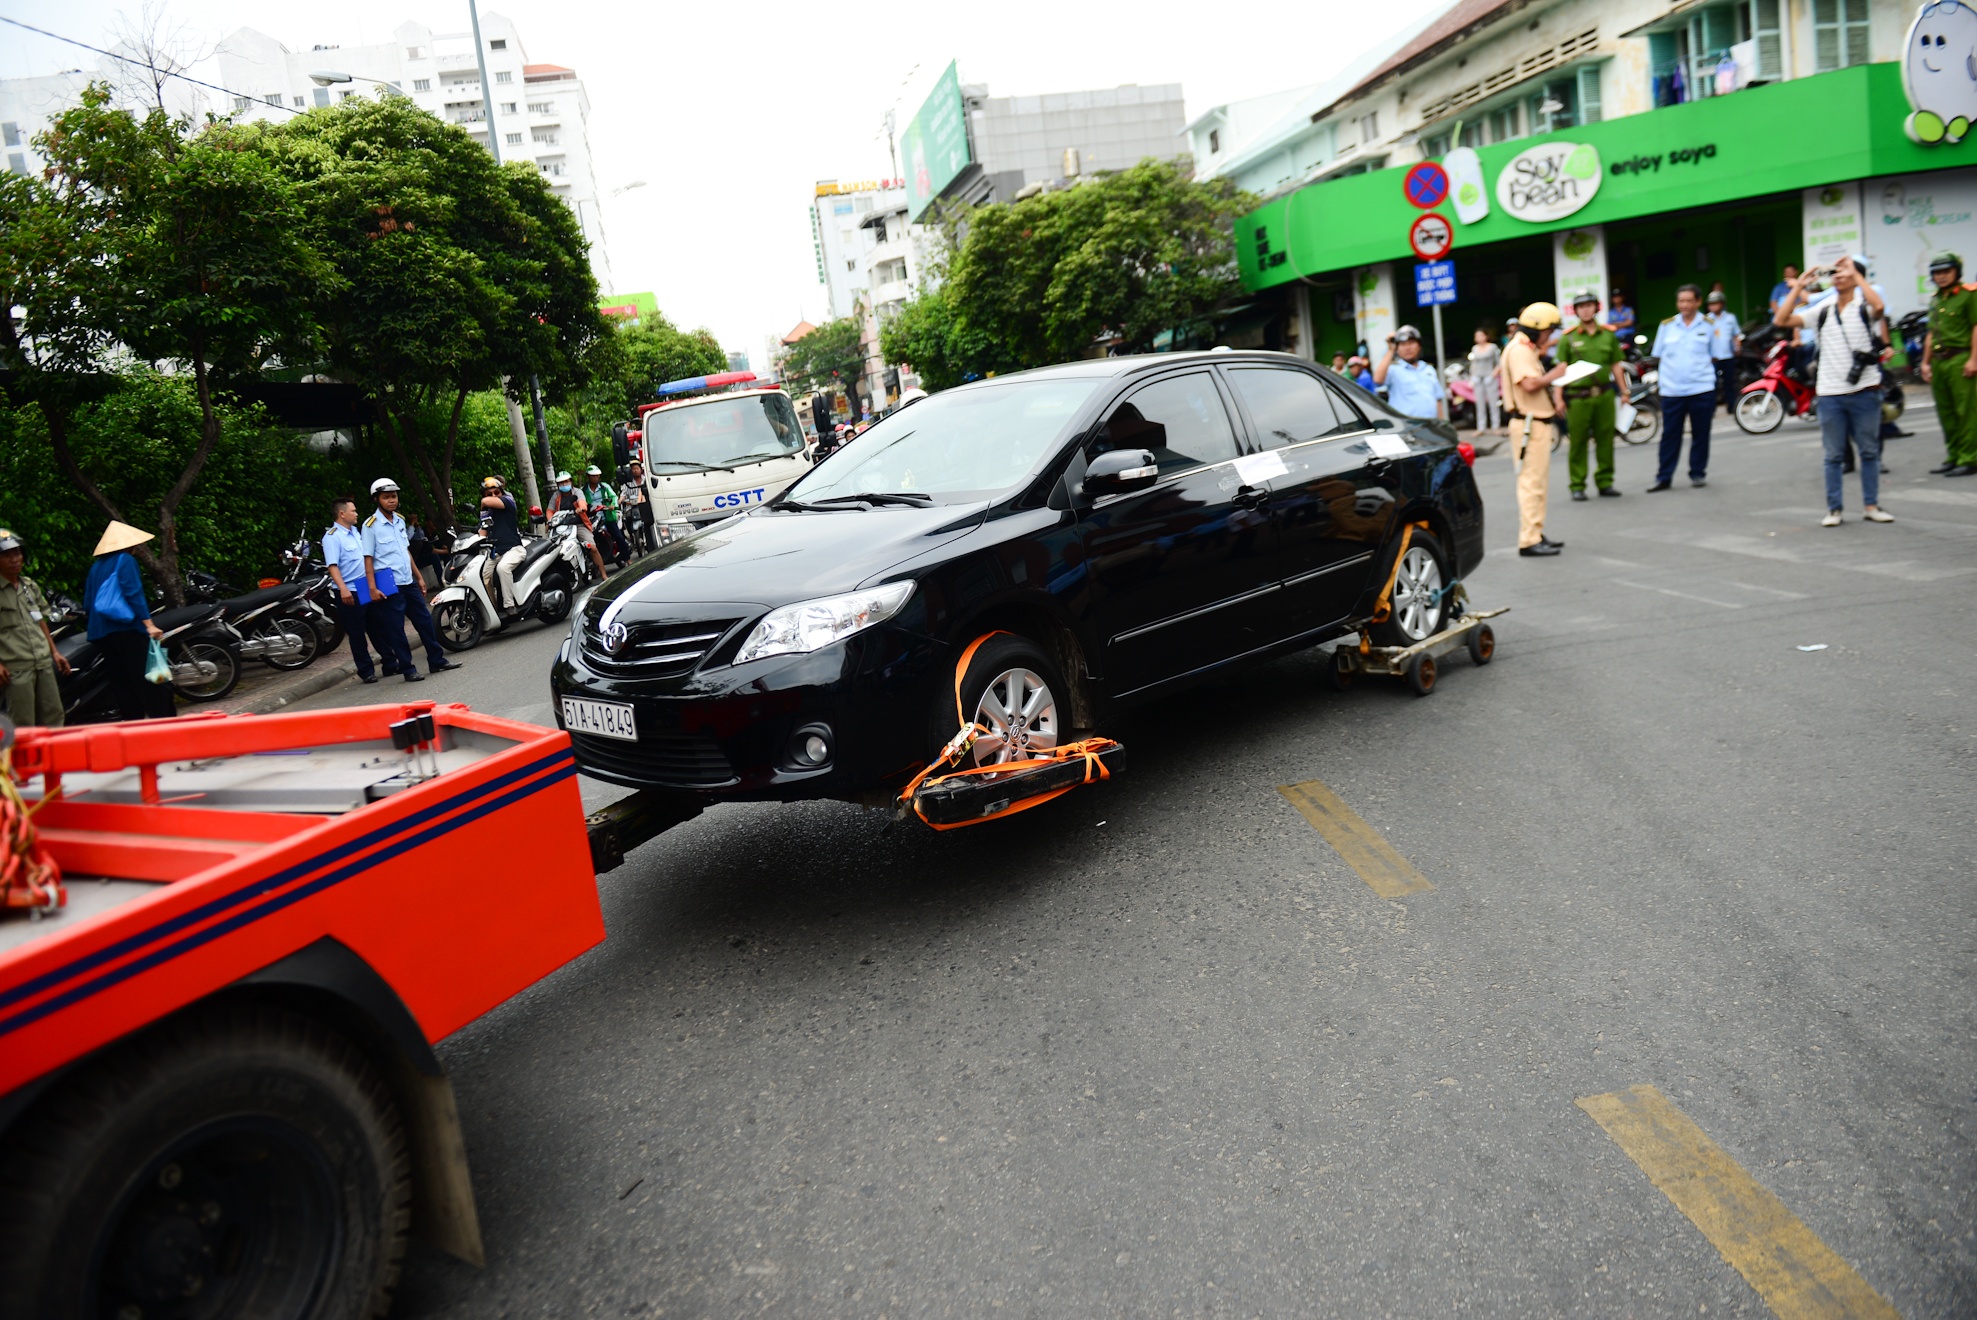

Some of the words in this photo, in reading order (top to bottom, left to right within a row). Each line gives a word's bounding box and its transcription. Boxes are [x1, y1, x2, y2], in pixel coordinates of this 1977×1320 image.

[1515, 153, 1565, 187] Soy
[1610, 153, 1662, 177] enjoy
[1669, 143, 1718, 165] soya
[1510, 178, 1579, 210] bean
[714, 487, 765, 508] CSTT
[564, 701, 633, 736] 51A-418.49
